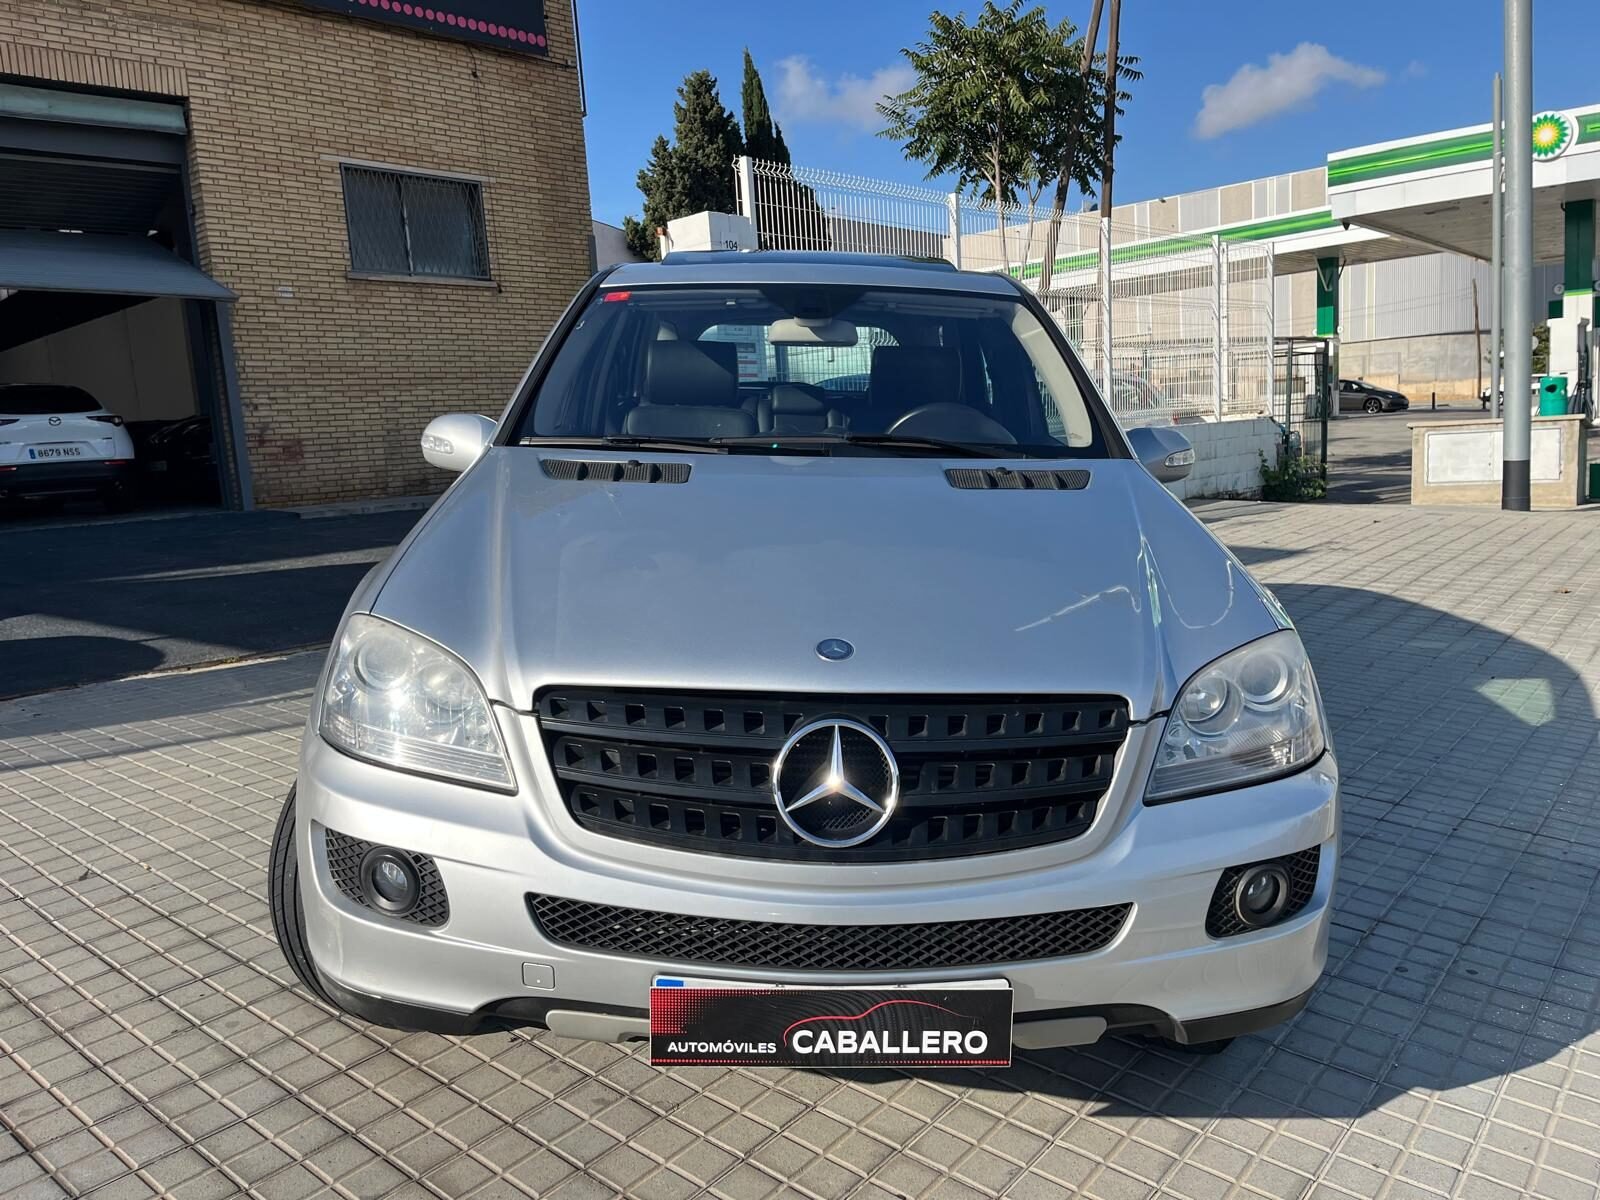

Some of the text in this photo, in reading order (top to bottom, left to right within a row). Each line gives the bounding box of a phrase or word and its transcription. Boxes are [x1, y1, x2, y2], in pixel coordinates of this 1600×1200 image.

[725, 239, 738, 251] 104
[667, 1029, 988, 1055] AUTOMÓVILES CABALLERO
